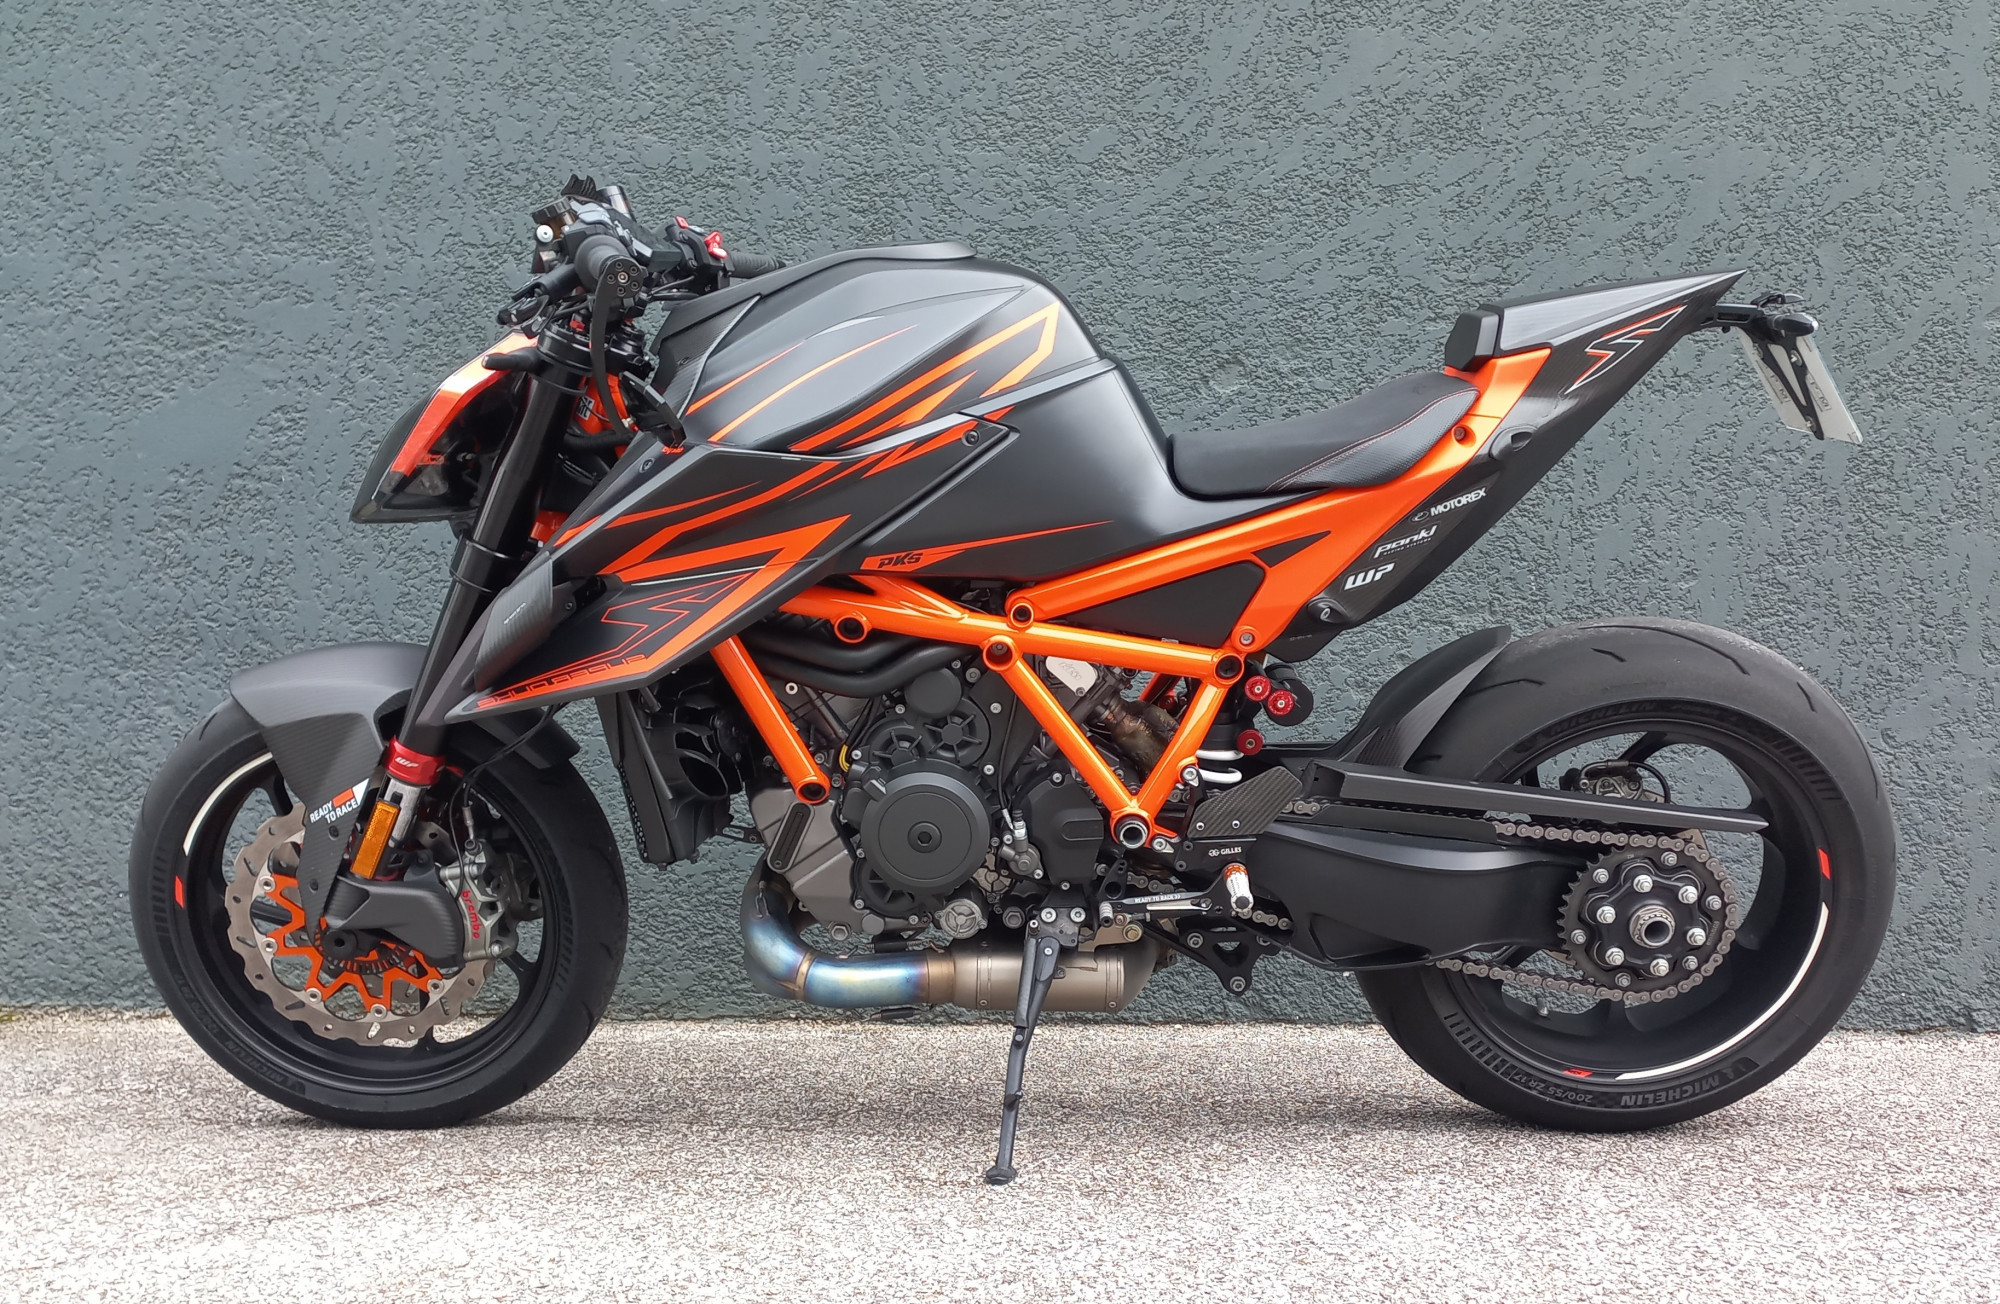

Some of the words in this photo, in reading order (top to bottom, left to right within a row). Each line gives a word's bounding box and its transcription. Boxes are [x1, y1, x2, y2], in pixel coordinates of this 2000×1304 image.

[1430, 487, 1487, 517] MOTOREX
[1373, 525, 1438, 559] pankl
[877, 551, 923, 569] PKS
[1343, 562, 1395, 591] WP
[395, 756, 419, 768] WP
[309, 800, 333, 823] READY
[325, 811, 337, 824] TO
[335, 798, 358, 818] RACE
[1220, 846, 1242, 855] GILLES
[461, 889, 482, 940] brembo
[1513, 1074, 1527, 1083] 17
[1528, 1079, 1546, 1091] ZR
[1620, 1074, 1719, 1106] MICHELIN
[1547, 1086, 1594, 1103] 200/55
